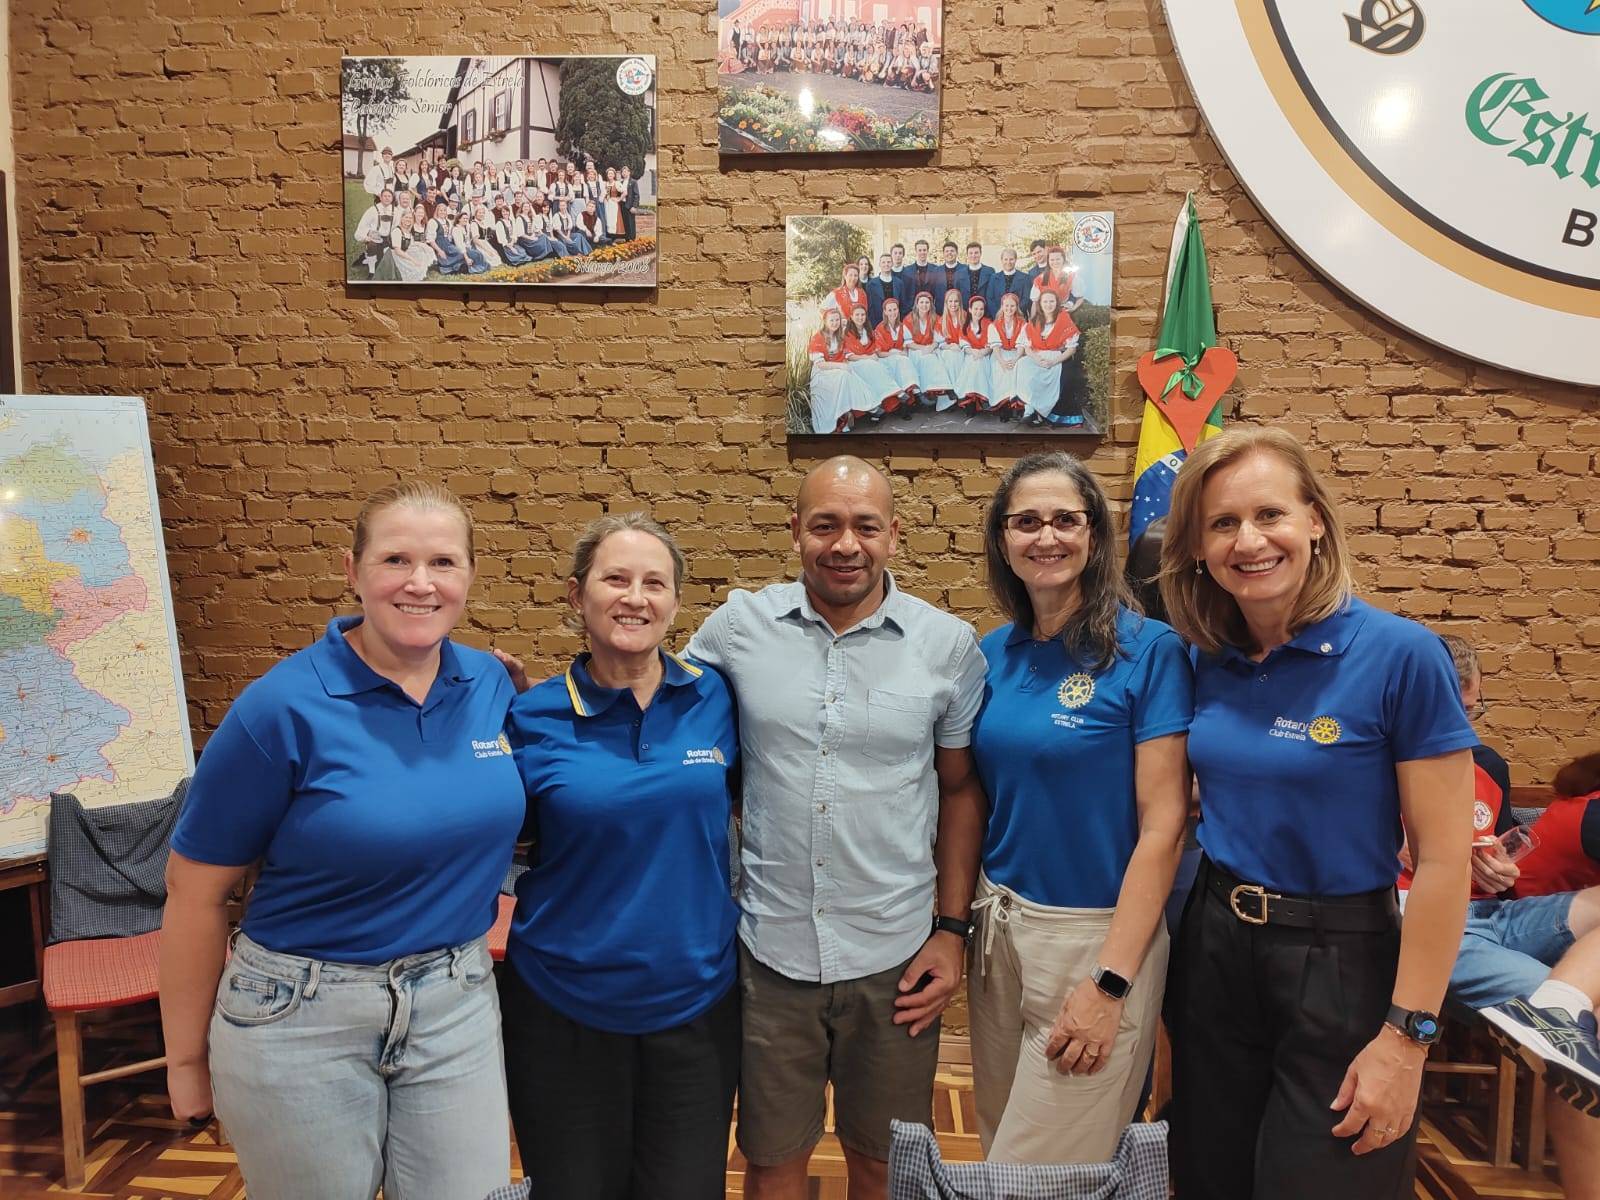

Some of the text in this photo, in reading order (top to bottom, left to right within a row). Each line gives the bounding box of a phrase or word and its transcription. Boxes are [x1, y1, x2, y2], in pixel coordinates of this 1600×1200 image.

[463, 68, 478, 87] de
[1274, 716, 1309, 733] Rotary
[1269, 728, 1284, 738] Club
[472, 740, 500, 751] Rotary
[687, 749, 714, 758] Rotary
